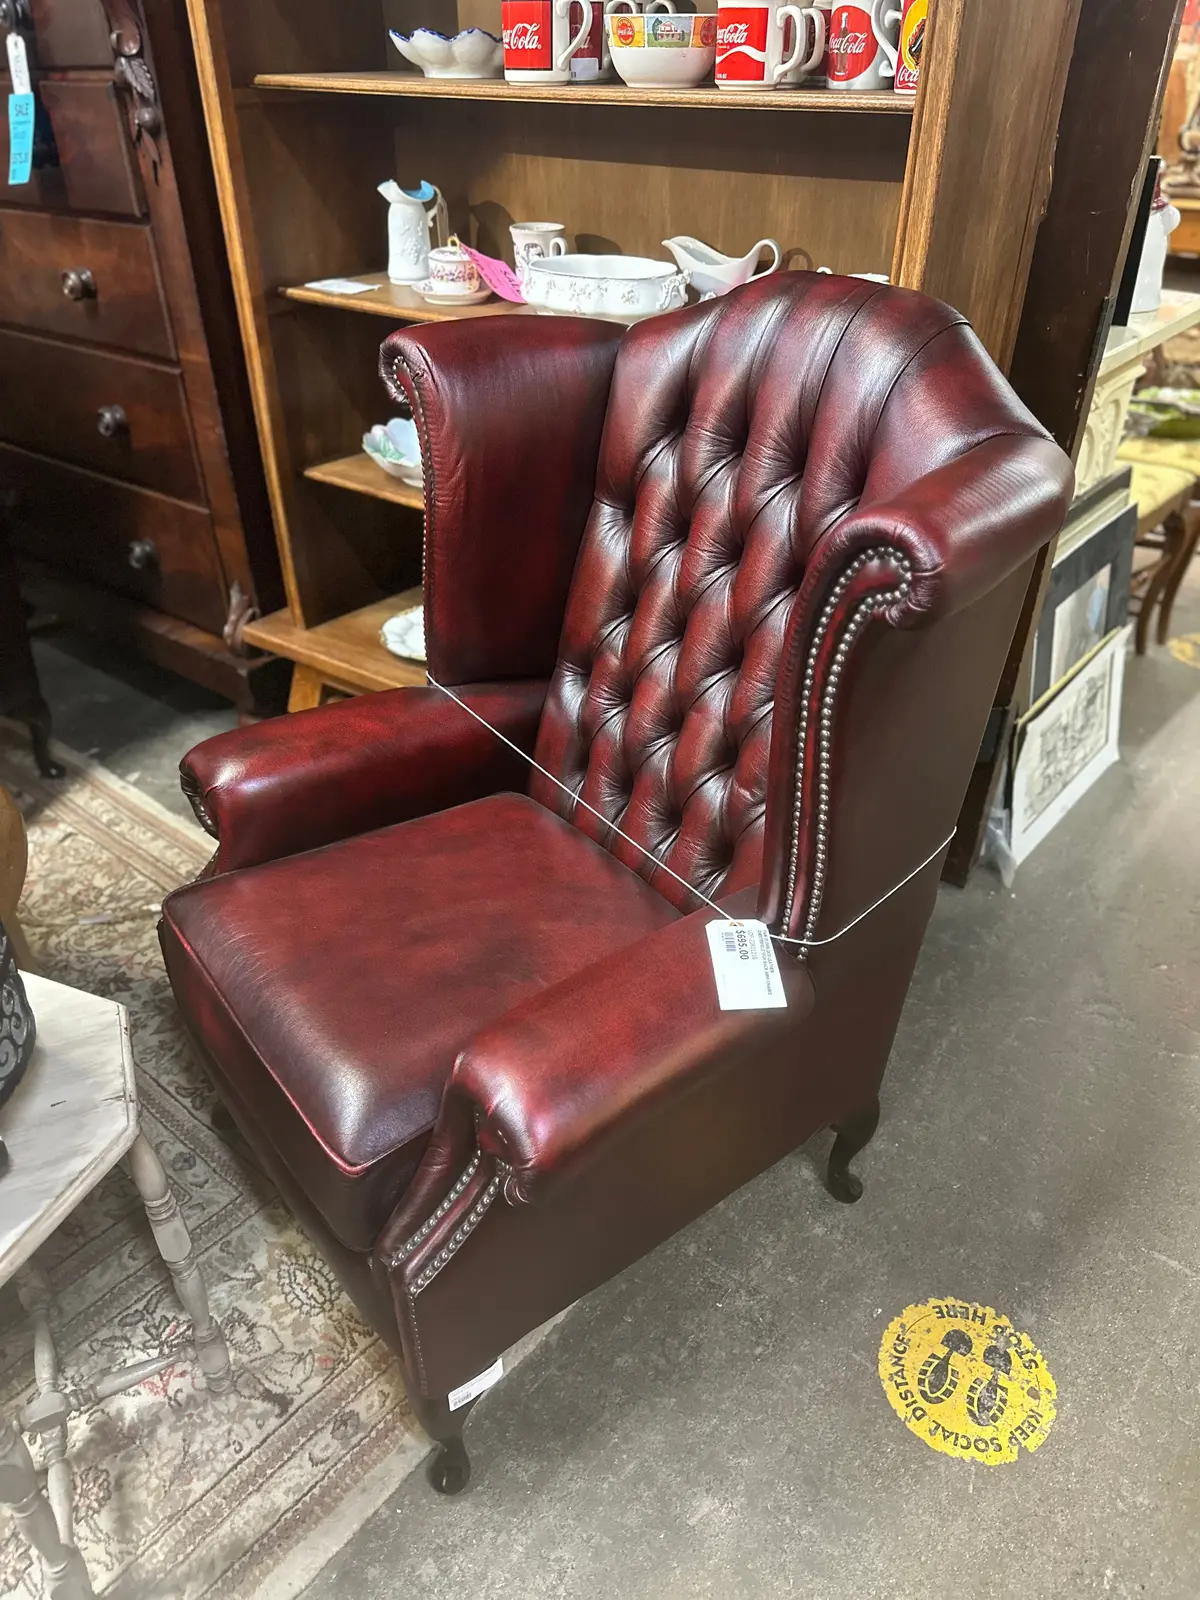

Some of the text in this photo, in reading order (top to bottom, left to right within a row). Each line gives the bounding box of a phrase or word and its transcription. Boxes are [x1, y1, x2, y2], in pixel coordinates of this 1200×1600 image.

[736, 929, 749, 960] $695.00
[933, 1305, 986, 1325] HERE
[893, 1334, 1044, 1453] KEEP SOCIAL DISTANCE
